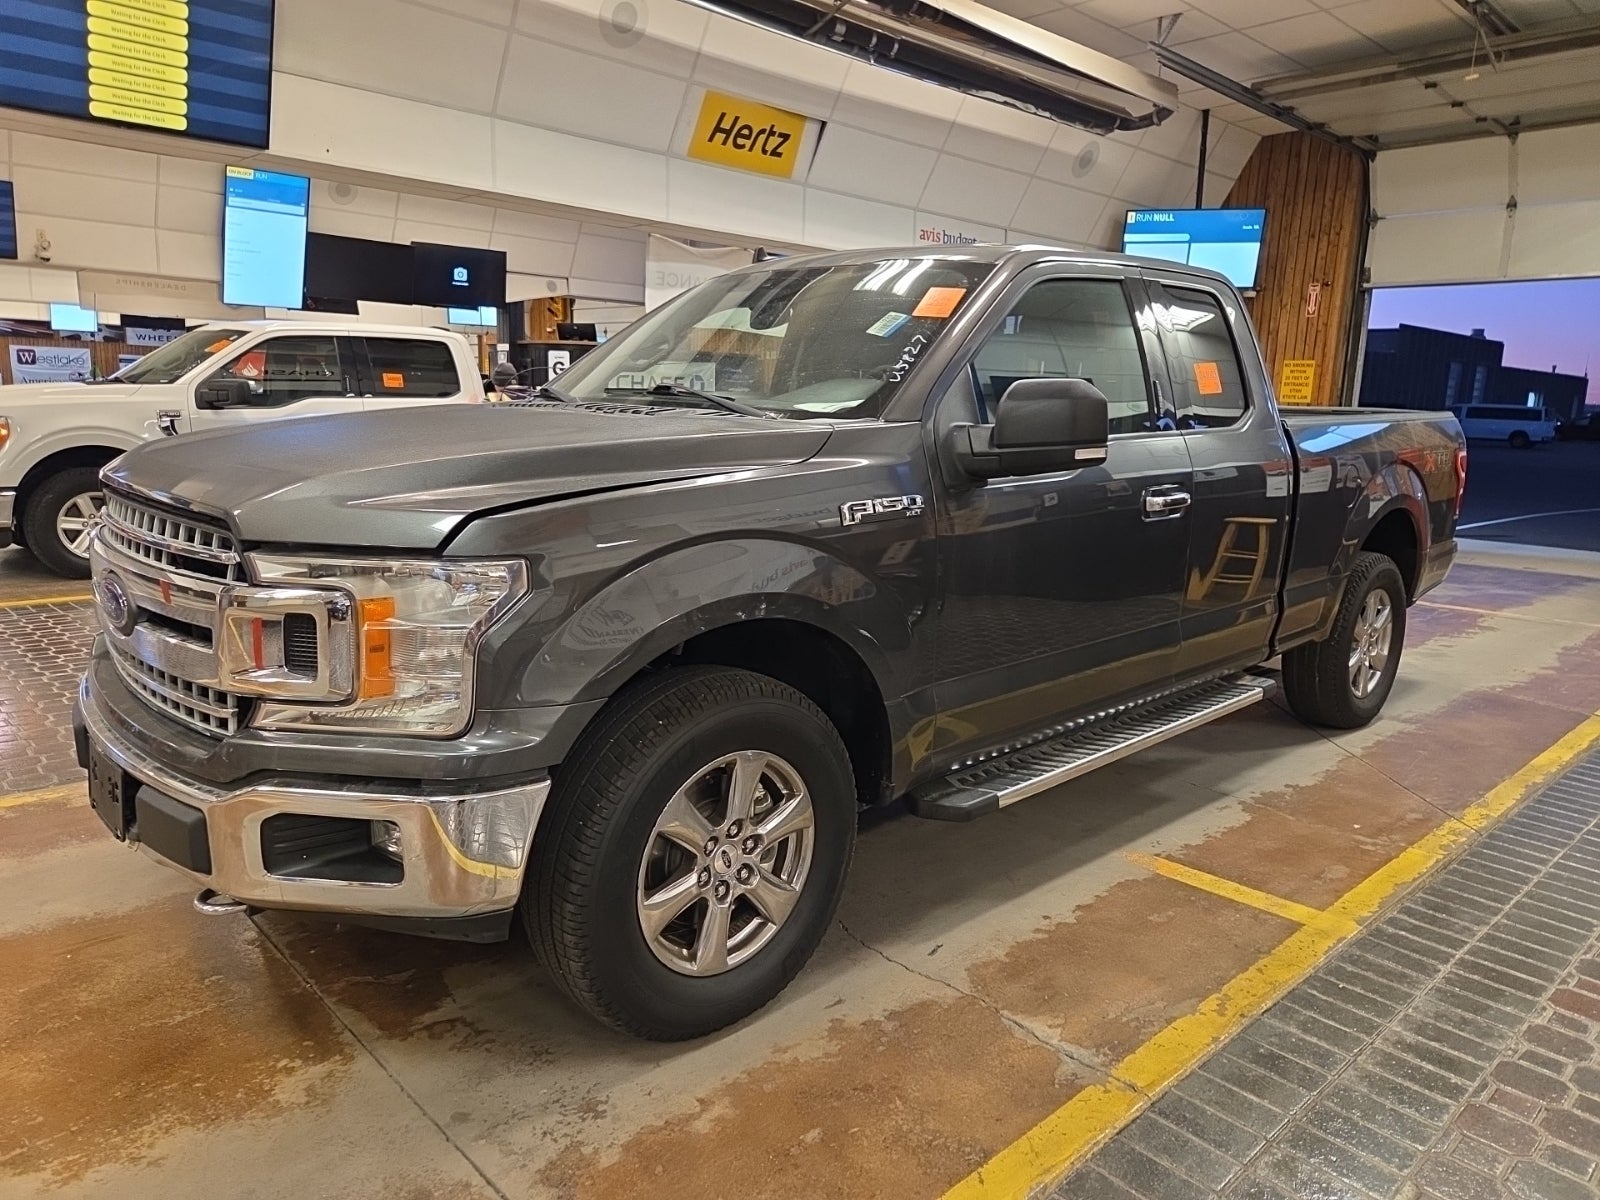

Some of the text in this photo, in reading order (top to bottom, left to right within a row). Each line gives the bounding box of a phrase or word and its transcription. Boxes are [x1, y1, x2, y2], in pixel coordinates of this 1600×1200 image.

[111, 9, 132, 19] Waiting
[112, 27, 132, 36] Waiting
[112, 44, 132, 53] Waiting
[112, 60, 132, 69] Waiting
[112, 77, 132, 85] Waiting
[112, 93, 132, 102] Waiting
[707, 111, 792, 158] Hertz
[1136, 213, 1152, 222] RUN
[1153, 213, 1175, 222] NULL
[919, 227, 941, 243] avis
[135, 333, 179, 342] WHEE
[17, 349, 85, 366] Westlake
[906, 508, 921, 517] XLT
